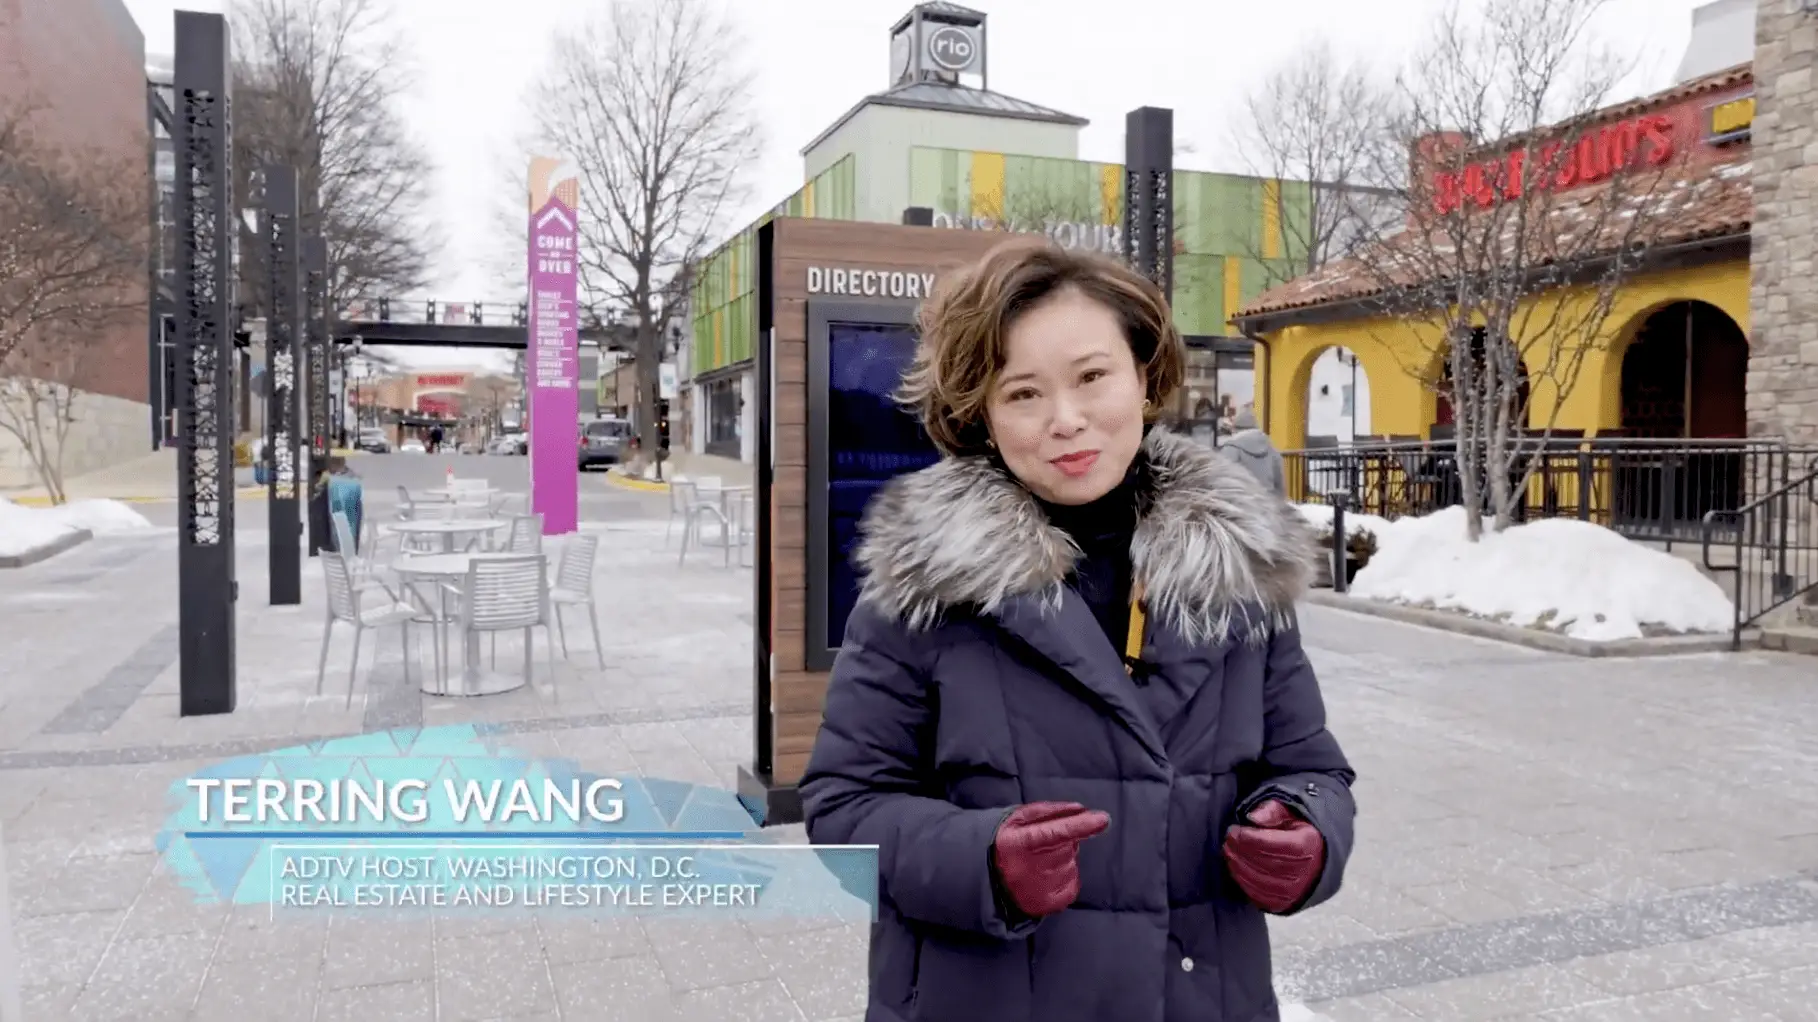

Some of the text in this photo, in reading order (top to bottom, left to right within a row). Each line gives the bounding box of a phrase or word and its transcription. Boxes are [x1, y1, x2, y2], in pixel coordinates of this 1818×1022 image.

[937, 37, 970, 56] rio
[537, 234, 573, 250] COME
[538, 259, 572, 274] OVER
[807, 266, 935, 298] DIRECTORY
